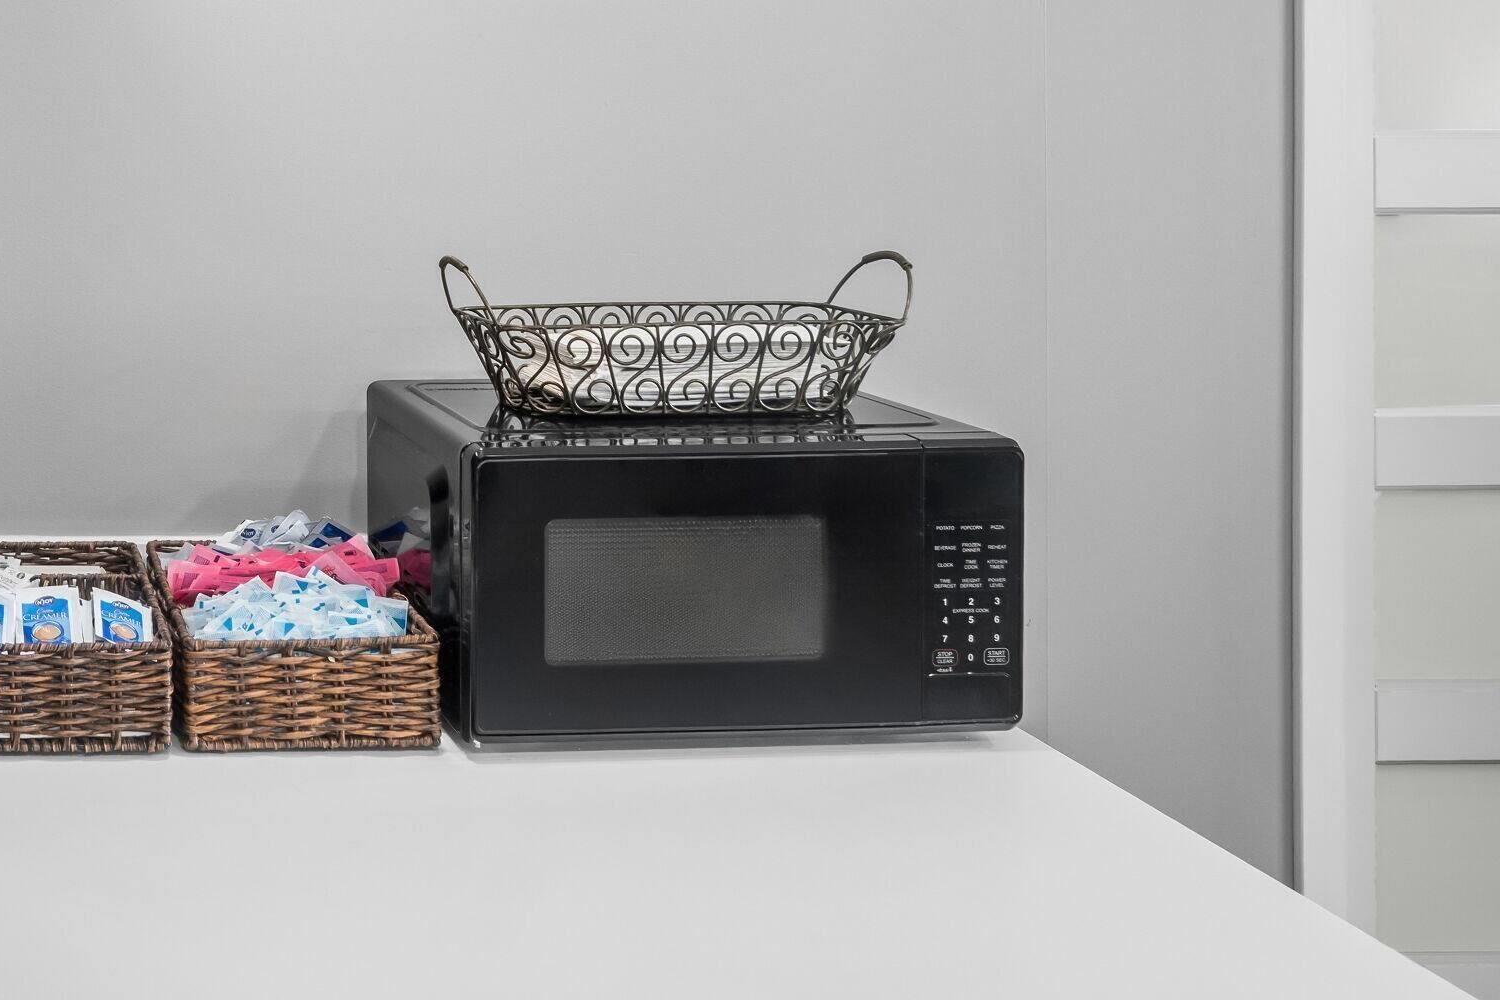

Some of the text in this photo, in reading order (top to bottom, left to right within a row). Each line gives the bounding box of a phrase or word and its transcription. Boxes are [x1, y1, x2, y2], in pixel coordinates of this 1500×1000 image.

[942, 598, 949, 606] 1
[968, 597, 975, 606] 2
[994, 596, 1001, 606] 3
[22, 611, 69, 621] CREAMER
[942, 616, 949, 625] 4
[968, 615, 975, 624] 5
[993, 615, 1001, 624] 6
[942, 634, 949, 643] 7
[968, 634, 975, 643] 8
[993, 633, 1001, 642] 9
[967, 653, 975, 662] 0
